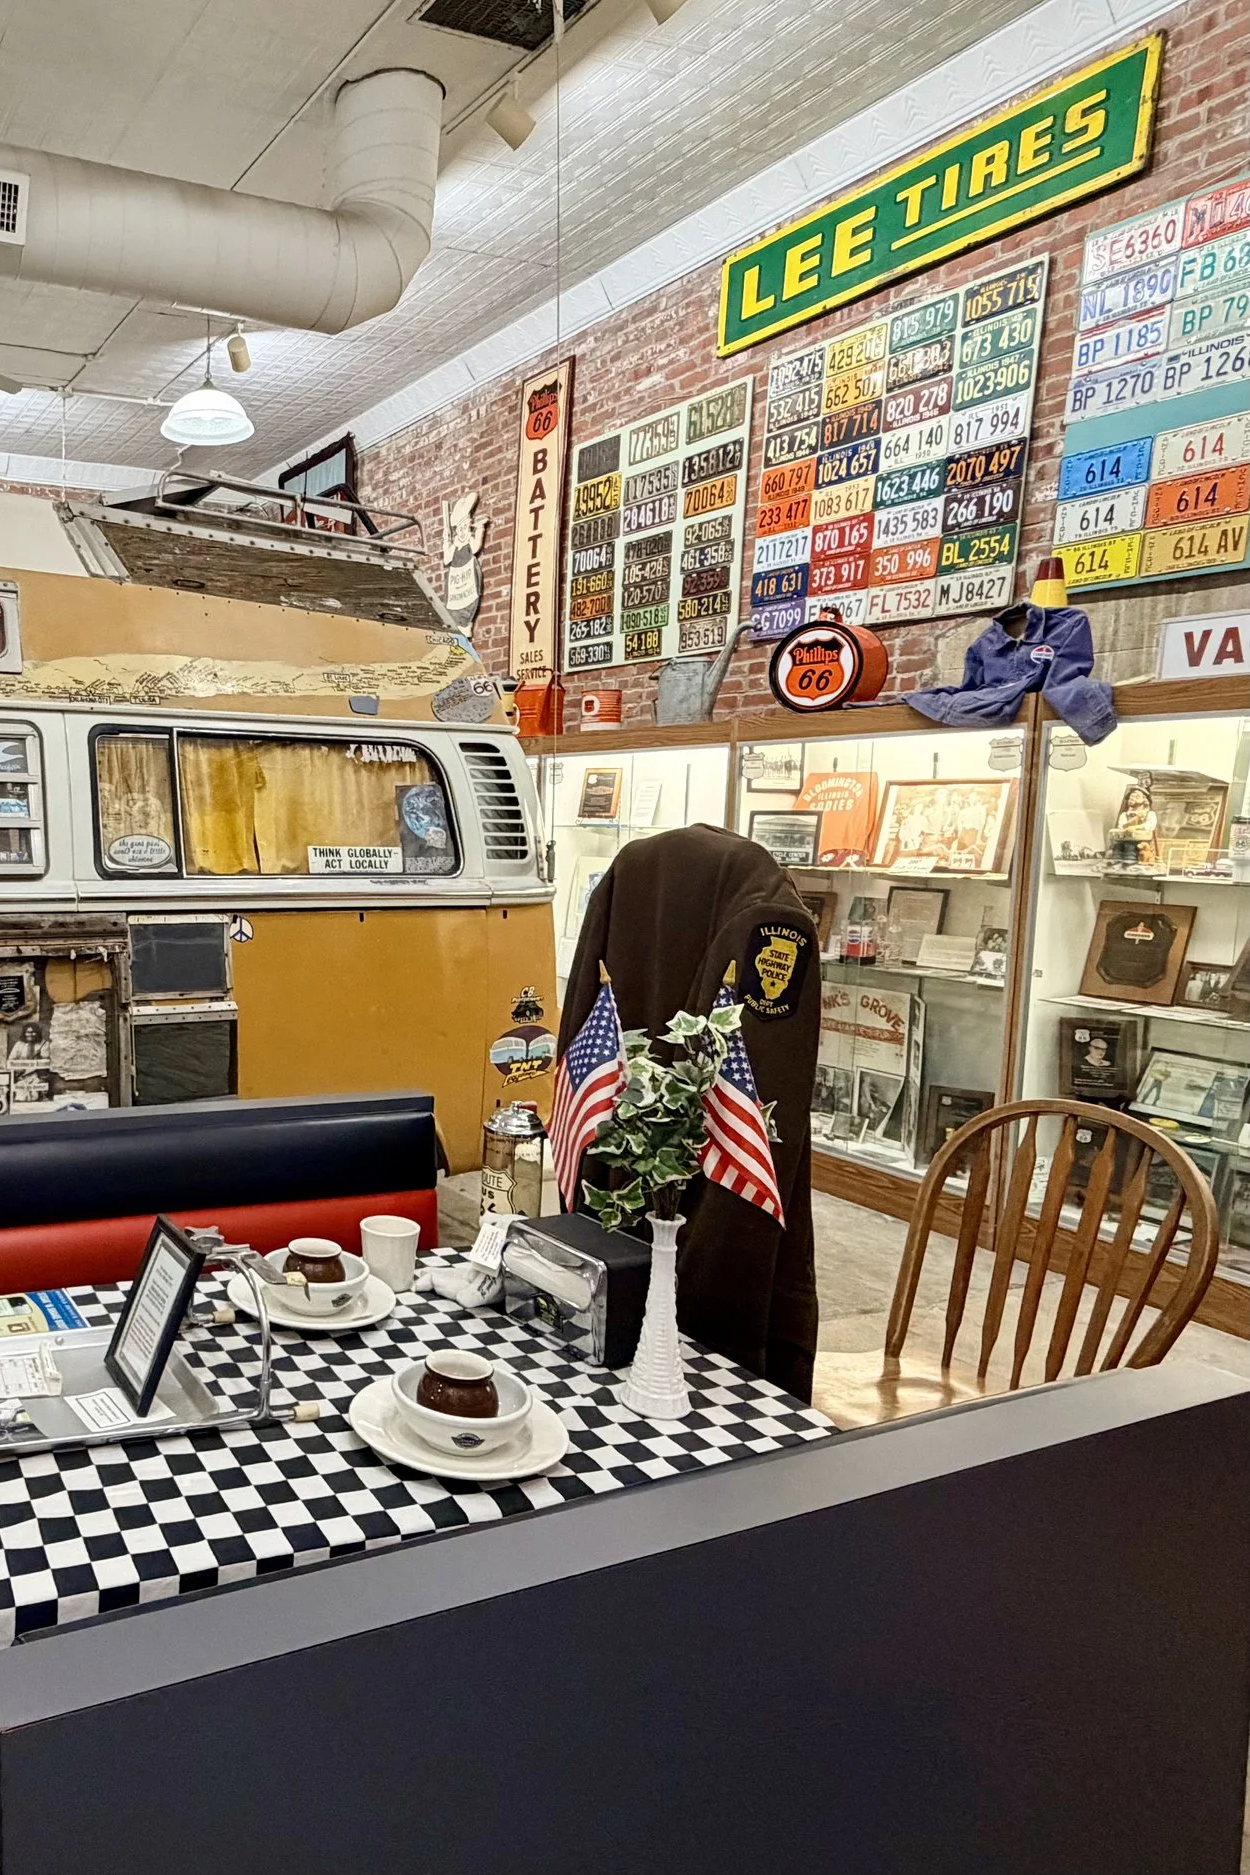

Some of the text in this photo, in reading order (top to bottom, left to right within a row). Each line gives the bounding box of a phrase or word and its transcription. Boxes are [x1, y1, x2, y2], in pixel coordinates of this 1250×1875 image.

[740, 88, 1109, 321] LEE TIRES
[1180, 251, 1217, 289] FB
[965, 287, 1002, 322] 1055
[1082, 268, 1172, 322] NL 1890
[893, 300, 954, 343] 815 979
[1181, 304, 1213, 336] BP
[962, 319, 1032, 362] 673 430
[1078, 319, 1164, 367] BP 1185
[1188, 335, 1245, 359] ILLINOIS
[830, 345, 854, 370] 429
[966, 360, 1000, 378] ILLINOIS
[1163, 345, 1250, 391] BP 126
[770, 387, 819, 422] 532 415
[826, 384, 849, 409] 662
[887, 383, 948, 422] 820 278
[1071, 370, 1155, 413] BP 1270
[533, 410, 553, 433] 66
[824, 409, 878, 446] 817 714
[954, 406, 1020, 445] 817 994
[767, 426, 817, 459] 413 754
[822, 448, 852, 463] ILLINOIS
[884, 424, 943, 459] 664 140
[1183, 432, 1224, 463] 614
[765, 464, 811, 494] 660 797
[818, 449, 877, 484] 1024 657
[946, 446, 1022, 485] 2070 497
[1085, 456, 1121, 484] 614
[686, 481, 725, 515] 70064
[876, 468, 940, 502] 1623 446
[1176, 482, 1218, 512] 614
[624, 496, 669, 532] 284618
[759, 499, 808, 528] 233 477
[814, 488, 870, 519] 1083 617
[947, 489, 1013, 525] 266 190
[1080, 504, 1115, 531] 614
[686, 520, 723, 545] 92-065
[815, 522, 868, 552] 870 165
[877, 507, 939, 540] 1435 583
[523, 448, 548, 643] BATTERY
[941, 533, 1010, 566] BL 2554
[1173, 526, 1244, 560] 614 AV
[574, 546, 607, 573] 70064
[812, 560, 865, 588] 373 917
[874, 548, 931, 576] 350 996
[1075, 549, 1109, 575] 614
[755, 572, 803, 597] 418 631
[679, 593, 721, 619] 580-214
[868, 588, 931, 616] FL 7532
[520, 649, 544, 665] SALES
[570, 645, 604, 665] 569-330
[793, 646, 838, 664] Phillips
[473, 681, 494, 694] 66
[799, 669, 833, 691] 66
[313, 848, 341, 858] THINK
[325, 859, 389, 870] ACT LOCALLY
[760, 926, 808, 947] ILLINOIS
[758, 957, 792, 972] HIGHWAY
[770, 950, 790, 961] STATE
[762, 968, 788, 981] POLICE
[744, 994, 790, 1014] PUBLIC SAFETY
[860, 994, 905, 1033] GROVE
[510, 1059, 543, 1073] TNT
[481, 1186, 495, 1199] US
